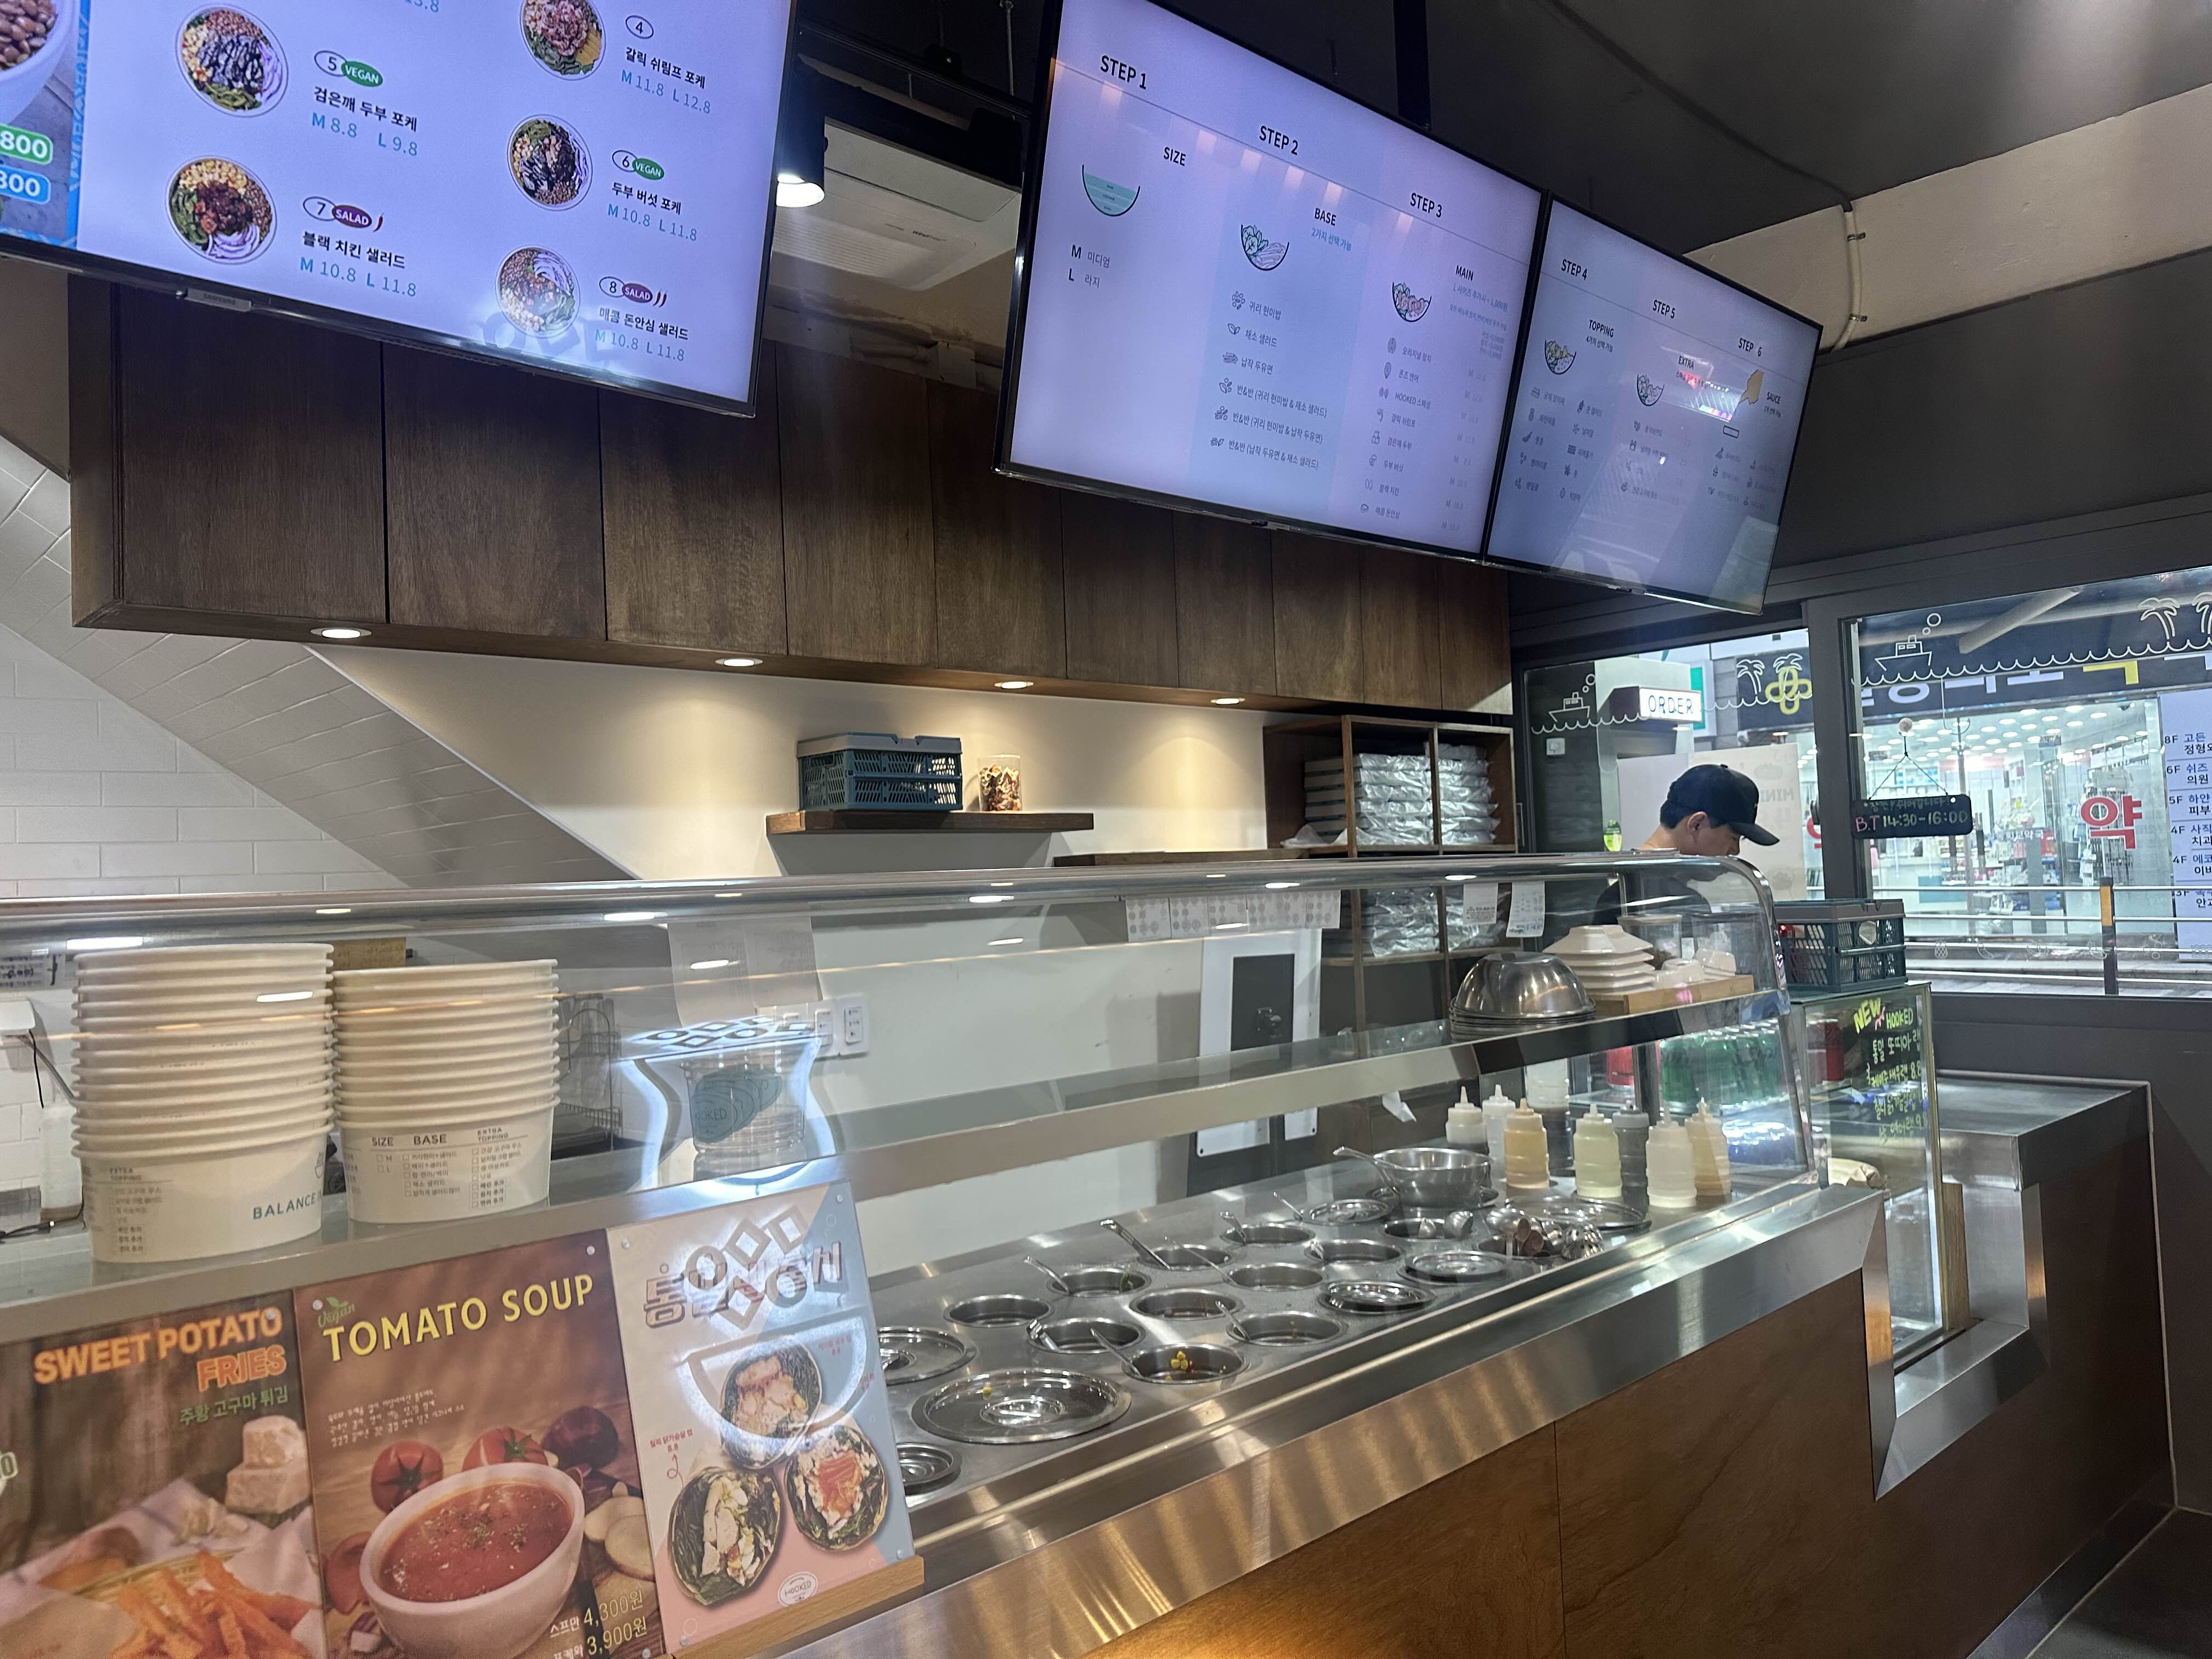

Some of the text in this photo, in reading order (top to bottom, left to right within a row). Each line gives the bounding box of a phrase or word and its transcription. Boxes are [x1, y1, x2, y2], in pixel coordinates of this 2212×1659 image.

[635, 21, 643, 34] 4
[328, 57, 379, 84] 5 VEGAN
[625, 46, 706, 89] 갈릭 쉬림프 포케
[1100, 55, 1147, 90] STEP 1
[622, 69, 711, 114] M 11.8 L 12.8
[314, 86, 417, 132] 검은깨 두부 포케
[0, 131, 48, 159] 800
[312, 112, 417, 156] M 8.8 L 9.8
[1259, 125, 1298, 156] STEP 2
[622, 156, 662, 178] 6 VEGAN
[1163, 146, 1186, 166] SIZE
[612, 182, 681, 215] 두부 버섯 포케
[1410, 193, 1443, 218] STEP 3
[317, 202, 369, 226] 7 SALAD
[607, 204, 697, 242] M 10.8 L 11.8
[1314, 208, 1336, 227] BASE
[302, 231, 405, 269] 블랙 치킨 샐러드
[1071, 244, 1110, 269] M 미디엄
[301, 257, 416, 297] M 10.8 L 11.8
[1068, 268, 1101, 289] L 라지
[1455, 265, 1474, 281] MAIN
[1561, 258, 1588, 280] STEP 4
[609, 281, 651, 301] 8 SALAD
[1249, 302, 1281, 320] 귀리 현미밥
[1653, 300, 1675, 319] STEP 5
[599, 306, 689, 341] 매콤 돈안심 샐러드
[1589, 319, 1614, 337] TOPPING
[595, 329, 685, 362] M 10.8 L 11.8
[1259, 334, 1277, 347] 샐러드
[1739, 338, 1762, 357] STEP 6
[1678, 356, 1695, 369] EXTRA
[1395, 392, 1416, 404] HOOKED
[1767, 392, 1781, 404] SAUCE
[1648, 695, 1693, 714] ORDER
[2164, 732, 2205, 744] 8F 고든
[2166, 763, 2208, 774] 6F 쉬즈
[2187, 774, 2208, 785] 의원
[2169, 796, 2183, 804] 5F
[2189, 805, 2211, 816] 피부
[1855, 815, 1880, 832] B.T
[2080, 795, 2142, 849] 약
[2171, 826, 2185, 834] 4F
[1854, 998, 1914, 1034] NEW HOOKED
[1873, 1034, 1911, 1064] 통밀 또띠아
[372, 1127, 502, 1147] SIZE BASE EXTRA
[253, 1192, 316, 1220] BALANCE
[323, 1273, 594, 1362] TOMATO SOUP
[34, 1307, 283, 1385] SWEET POTATO
[197, 1345, 287, 1392] FRIES
[179, 1385, 289, 1425] 주황 고구마 튀김
[785, 1581, 811, 1598] HOOKED
[550, 1588, 644, 1638] 스프만 4,300원
[587, 1615, 647, 1655] 3,900원
